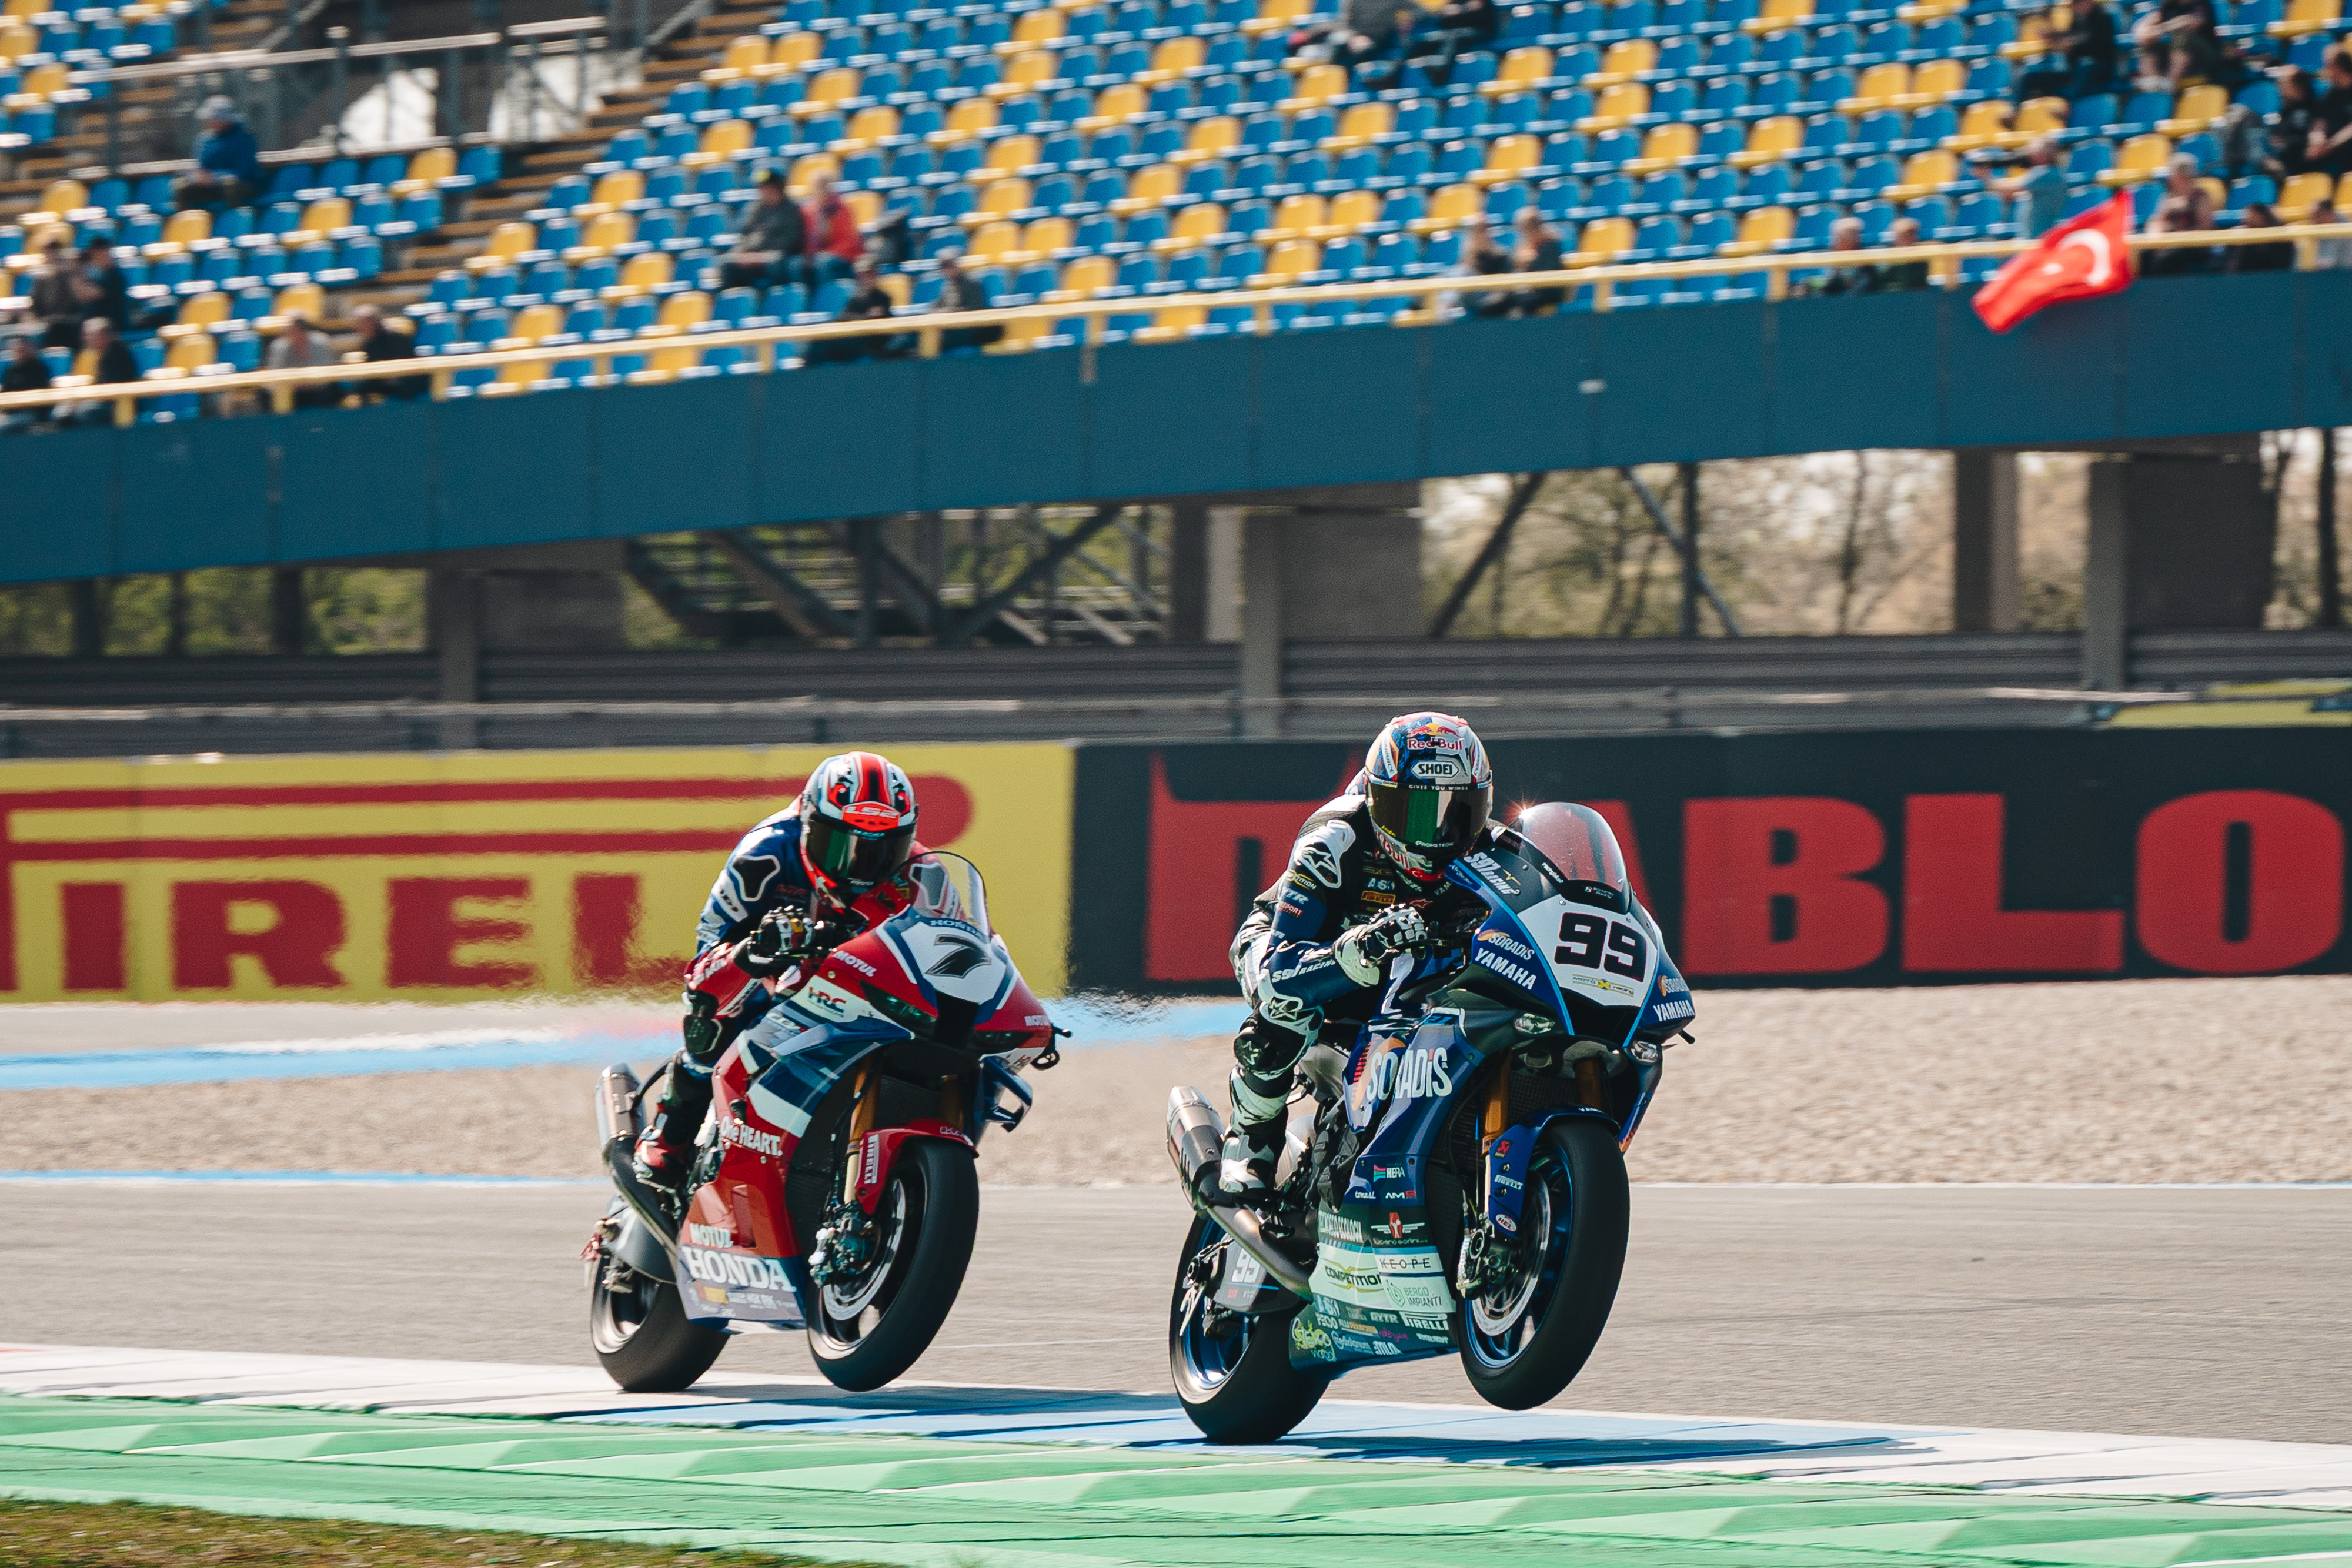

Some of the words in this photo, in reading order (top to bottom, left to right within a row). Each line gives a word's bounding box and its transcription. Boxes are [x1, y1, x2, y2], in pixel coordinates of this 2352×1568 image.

[1408, 737, 1436, 750] Red
[1439, 738, 1463, 750] Bull
[1418, 764, 1453, 775] SHOEI
[845, 807, 900, 818] LS2
[926, 934, 991, 978] 7
[1554, 912, 1648, 983] 99
[833, 950, 877, 977] MOTUL
[1475, 947, 1536, 990] YAMAHA
[808, 986, 847, 1014] HRC
[1653, 999, 1695, 1022] YAMAHA
[689, 1223, 734, 1248] MOTUL
[681, 1246, 797, 1293] HONDA
[1404, 1286, 1429, 1296] BERGO
[1408, 1295, 1442, 1307] IMPIANTI
[1399, 1310, 1449, 1330] PIRELLI
